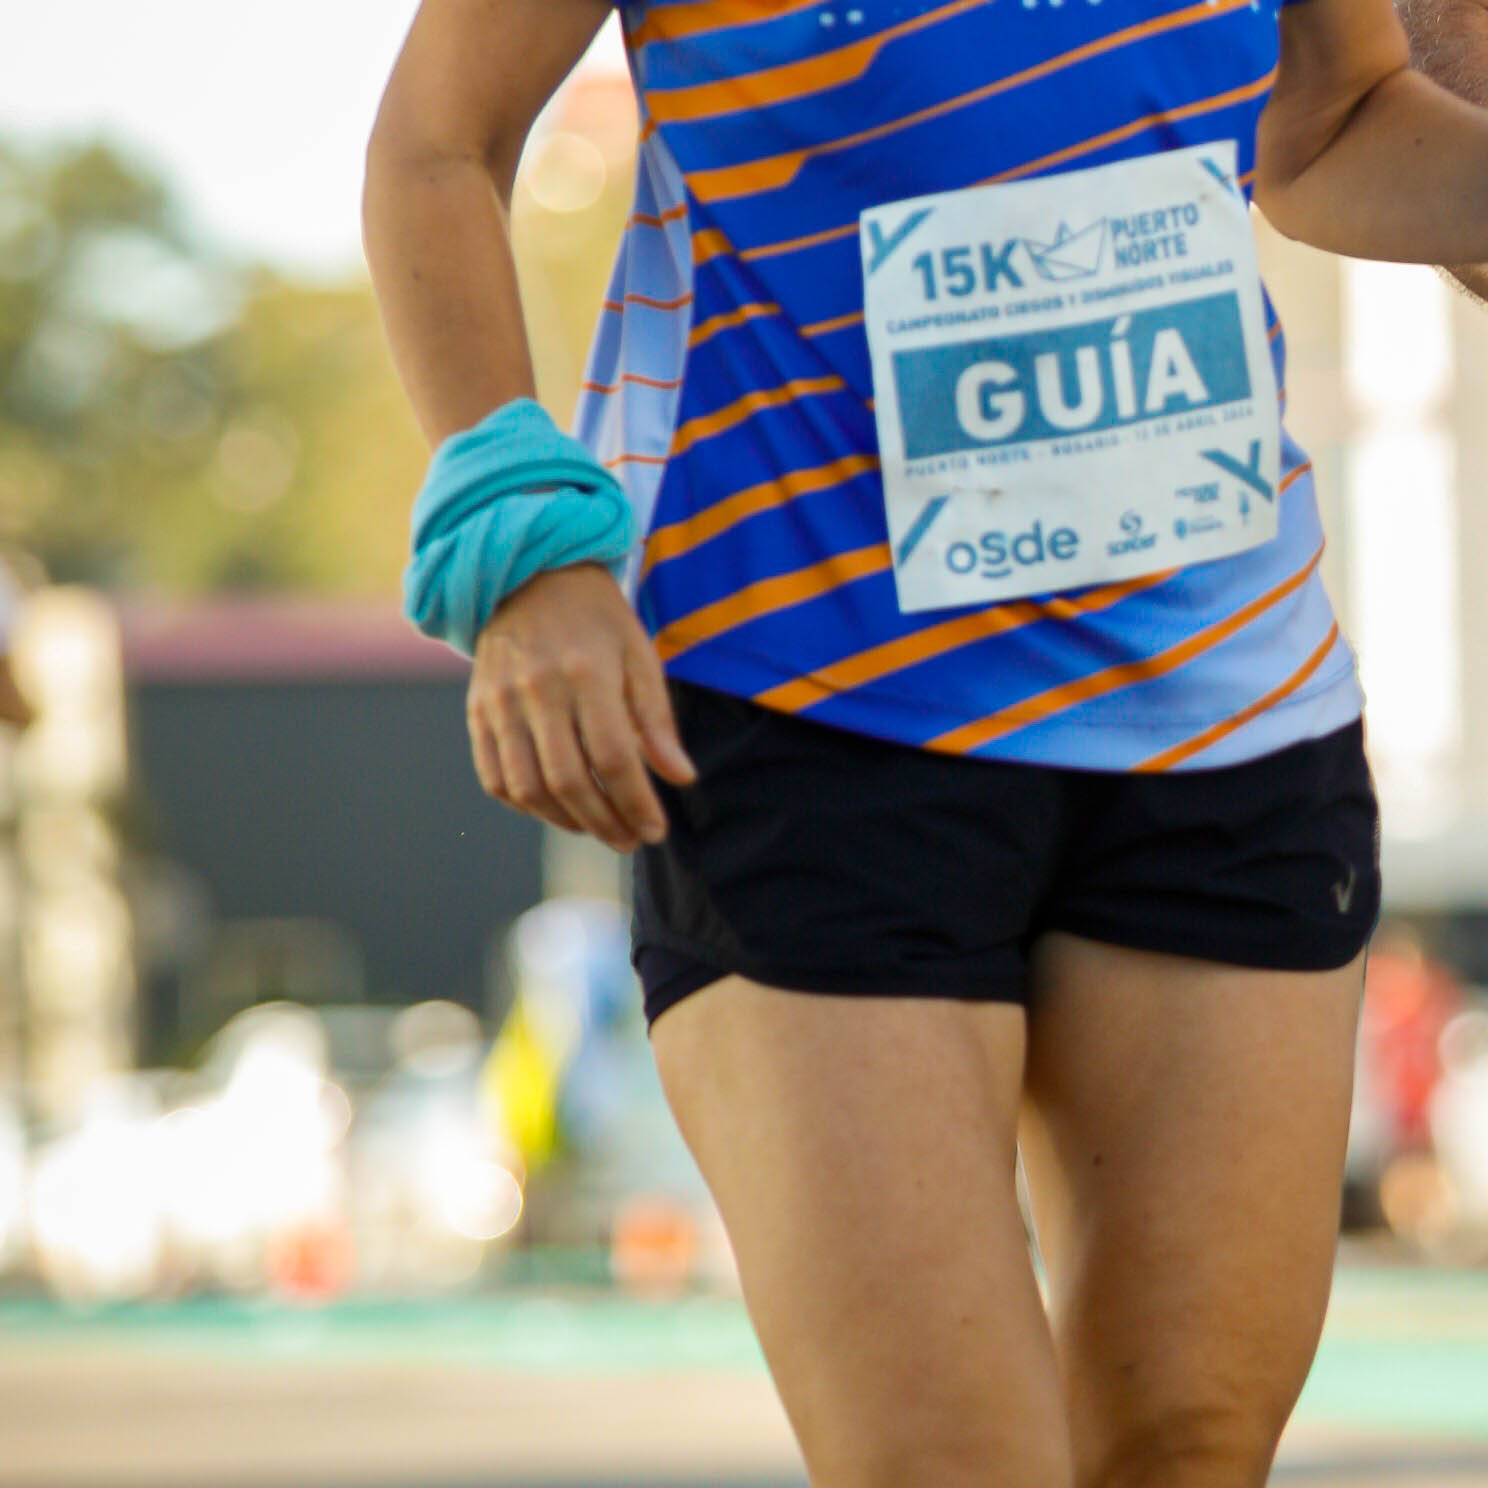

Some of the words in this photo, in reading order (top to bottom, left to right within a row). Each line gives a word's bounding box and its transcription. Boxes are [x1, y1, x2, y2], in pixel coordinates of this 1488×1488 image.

[1110, 203, 1200, 239] PUERTO
[912, 237, 1025, 301] 15K
[1115, 232, 1188, 268] NORTE
[885, 306, 999, 334] CAMPEONATO
[954, 315, 1210, 443] GUÍA
[945, 519, 1080, 581] osde
